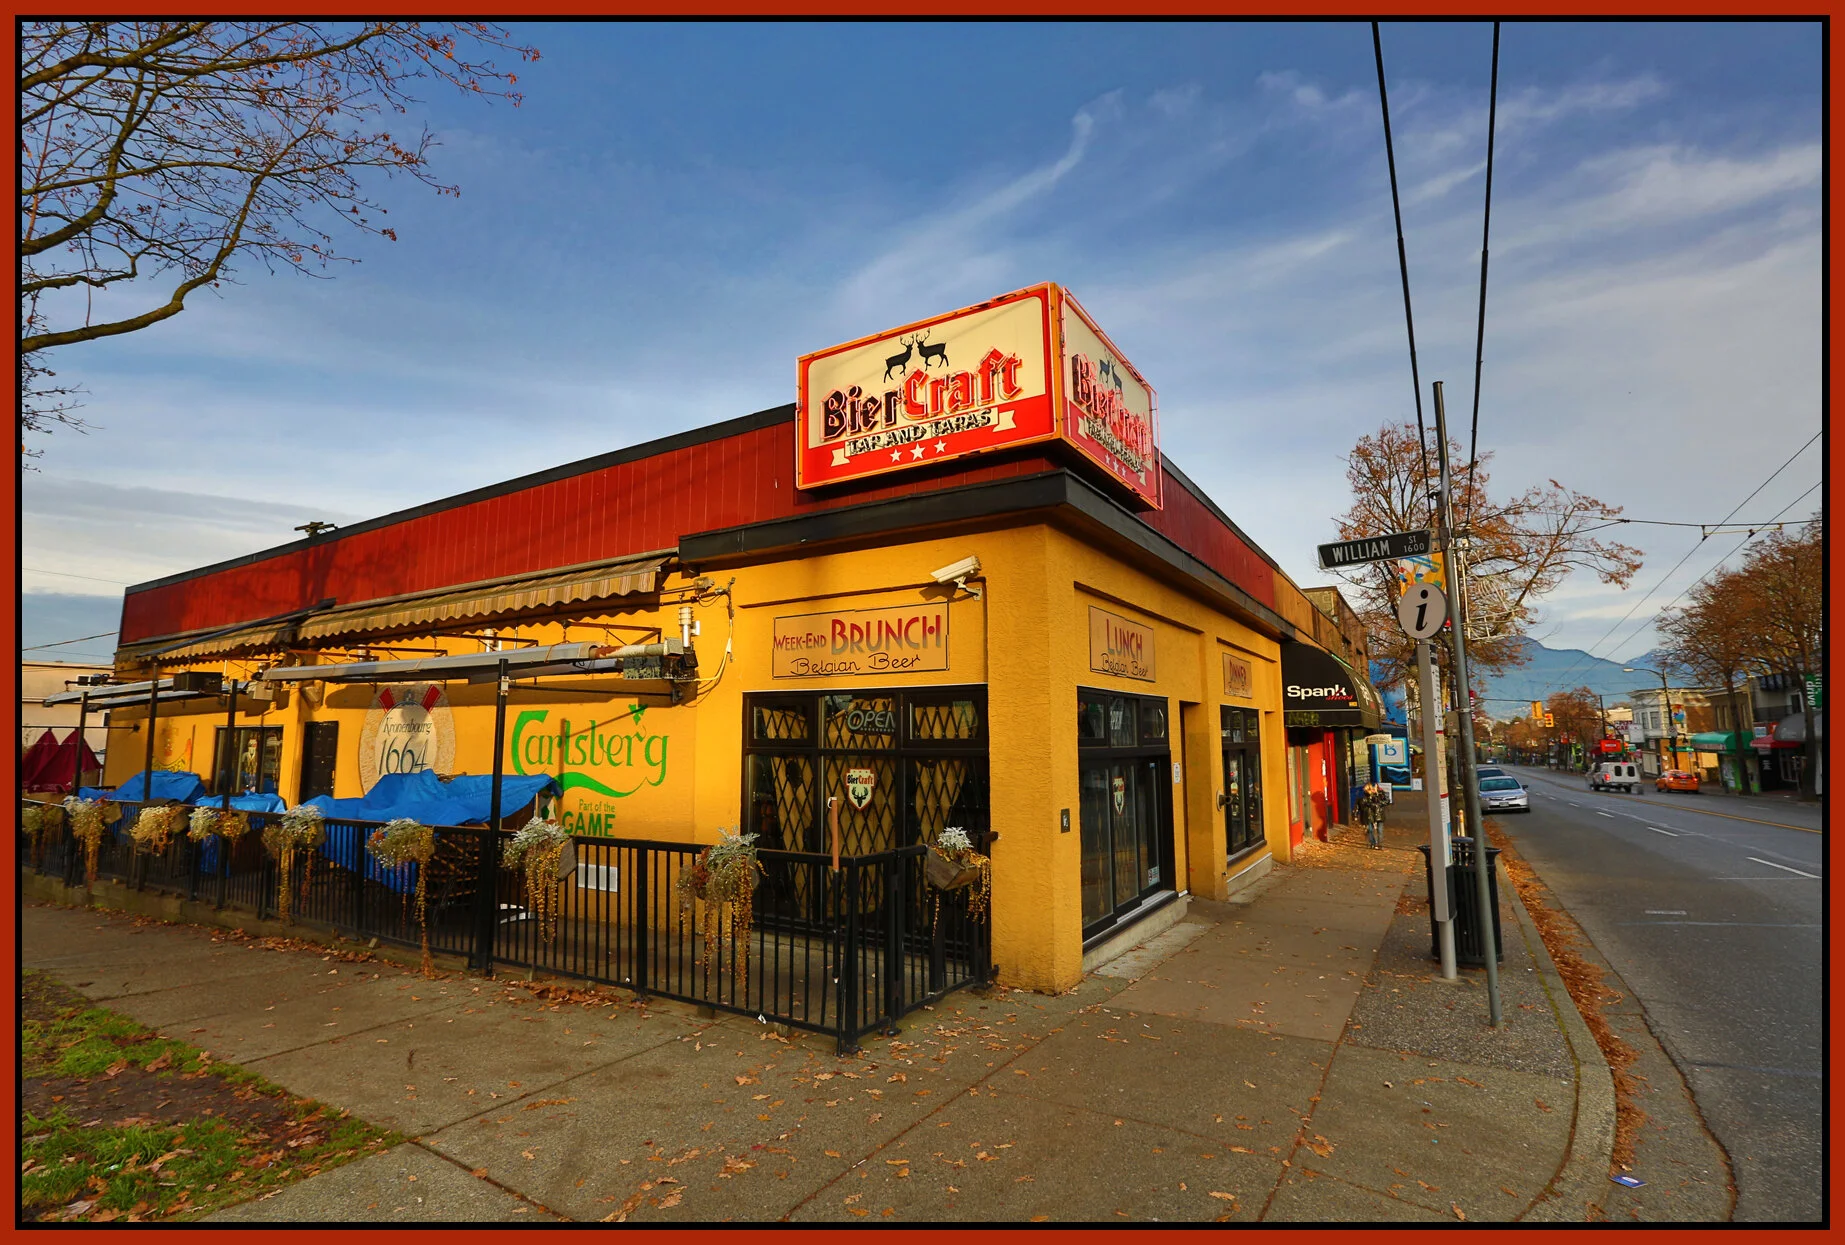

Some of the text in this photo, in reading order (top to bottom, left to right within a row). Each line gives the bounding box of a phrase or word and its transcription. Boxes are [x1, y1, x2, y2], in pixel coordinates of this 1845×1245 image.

[819, 346, 1023, 442] BierCraft
[886, 424, 928, 447] AND
[929, 408, 992, 437] TAPAS
[1332, 535, 1417, 563] WILLIAM ST
[1403, 543, 1425, 553] 1600
[831, 614, 942, 656] BRUNCH
[1106, 618, 1143, 662] LUNCH
[790, 652, 921, 676] Belgian Beer
[1287, 684, 1347, 700] Spank
[383, 717, 433, 735] Kronenbourg
[378, 736, 429, 776] 1664
[511, 709, 669, 787] Carlsberg
[847, 774, 873, 785] BierCraft
[579, 798, 616, 813] Part of the
[562, 811, 616, 838] GAME
